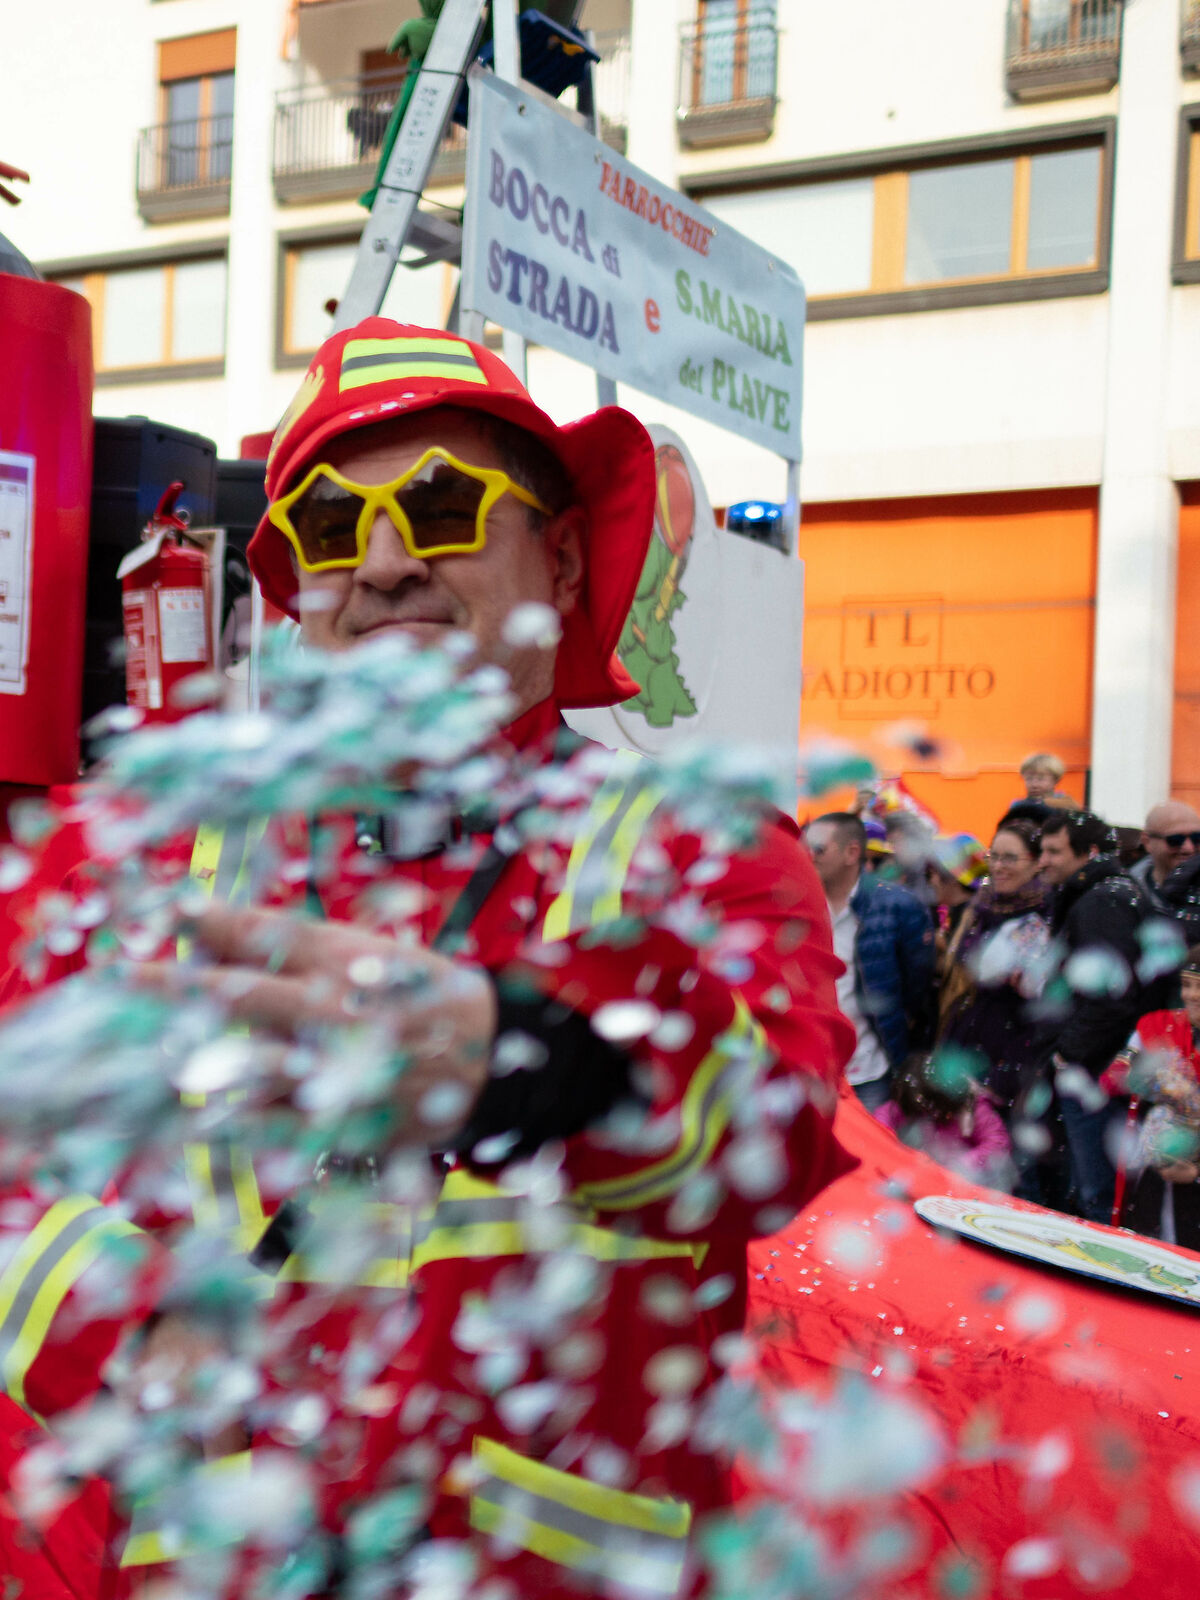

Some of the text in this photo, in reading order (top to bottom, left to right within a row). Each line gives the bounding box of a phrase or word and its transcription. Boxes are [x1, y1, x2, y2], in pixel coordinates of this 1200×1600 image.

[489, 148, 622, 279] BOCCA di
[599, 161, 713, 257] PARROCCHIE
[486, 239, 620, 355] STRADA
[644, 298, 661, 334] e
[675, 268, 793, 367] S.MARIA
[711, 356, 790, 434] PIAVE
